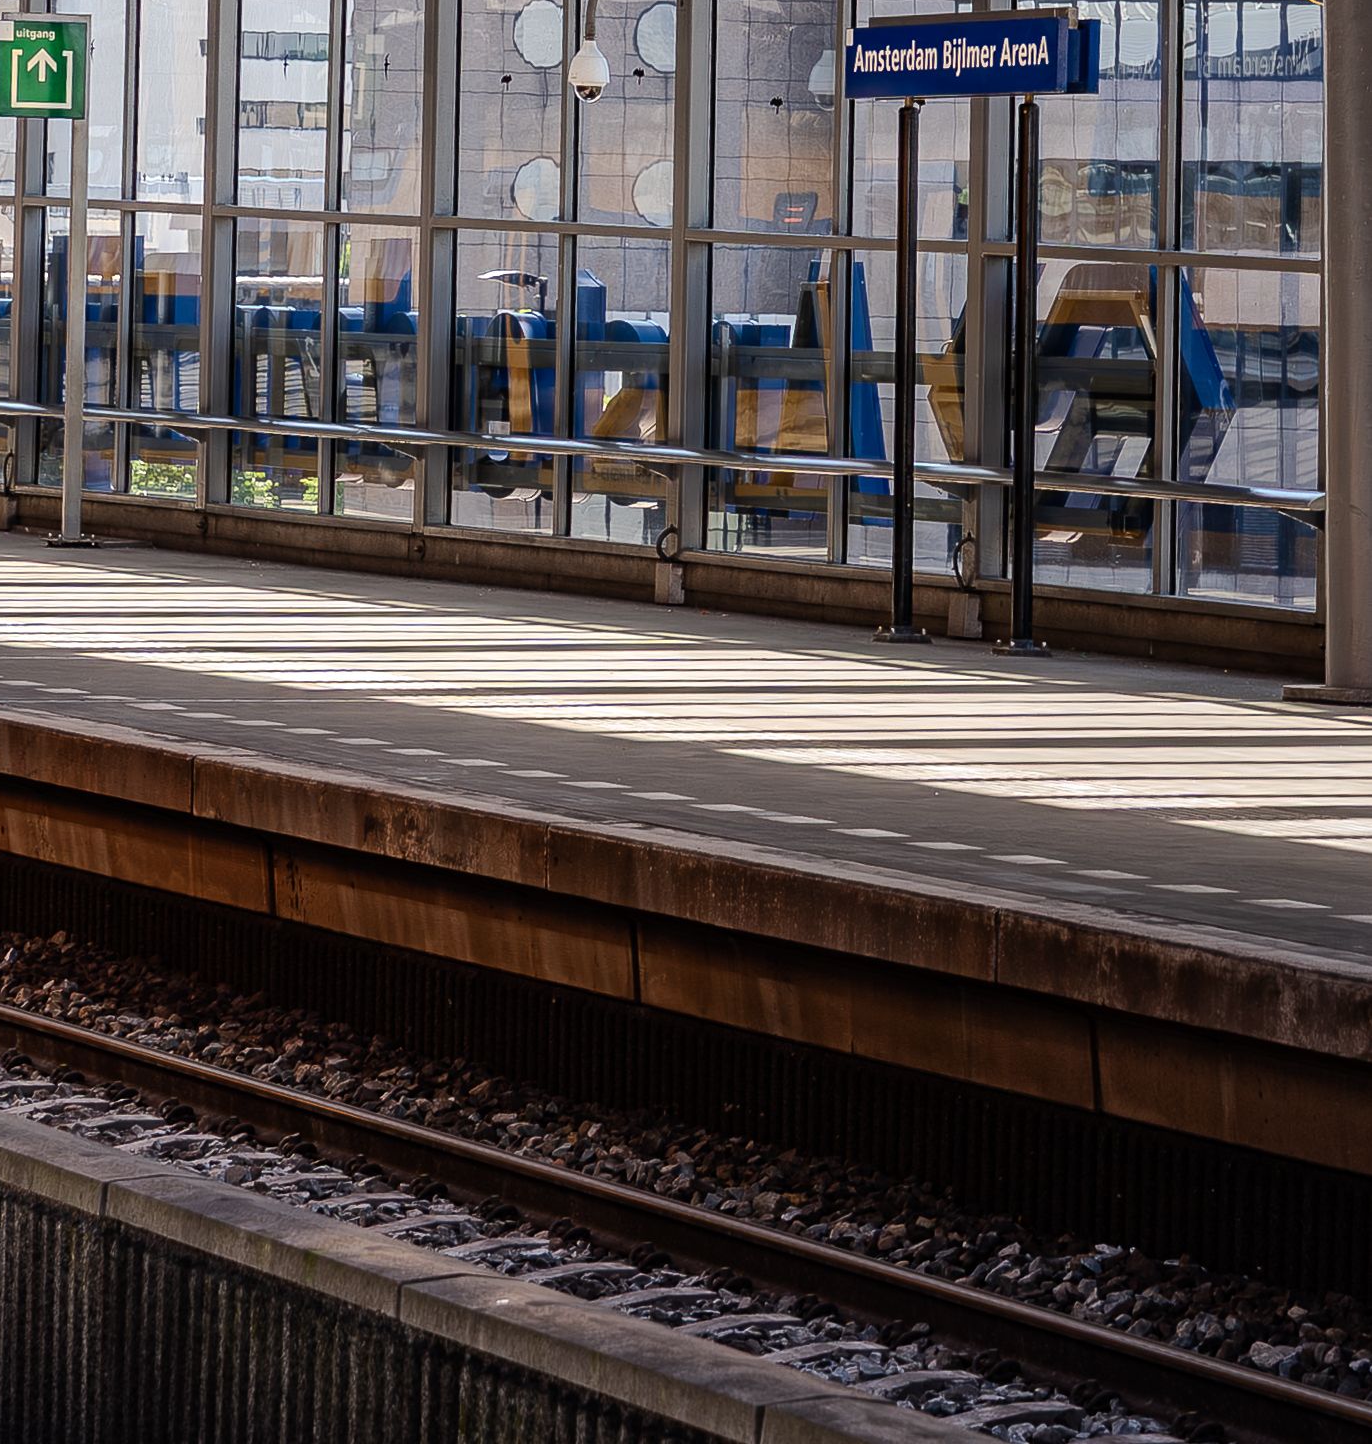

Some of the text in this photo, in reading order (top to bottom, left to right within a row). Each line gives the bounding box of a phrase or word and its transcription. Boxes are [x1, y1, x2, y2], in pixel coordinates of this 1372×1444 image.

[16, 28, 56, 40] uitgang
[853, 35, 1049, 77] Amsterdam Bijlmer ArenA
